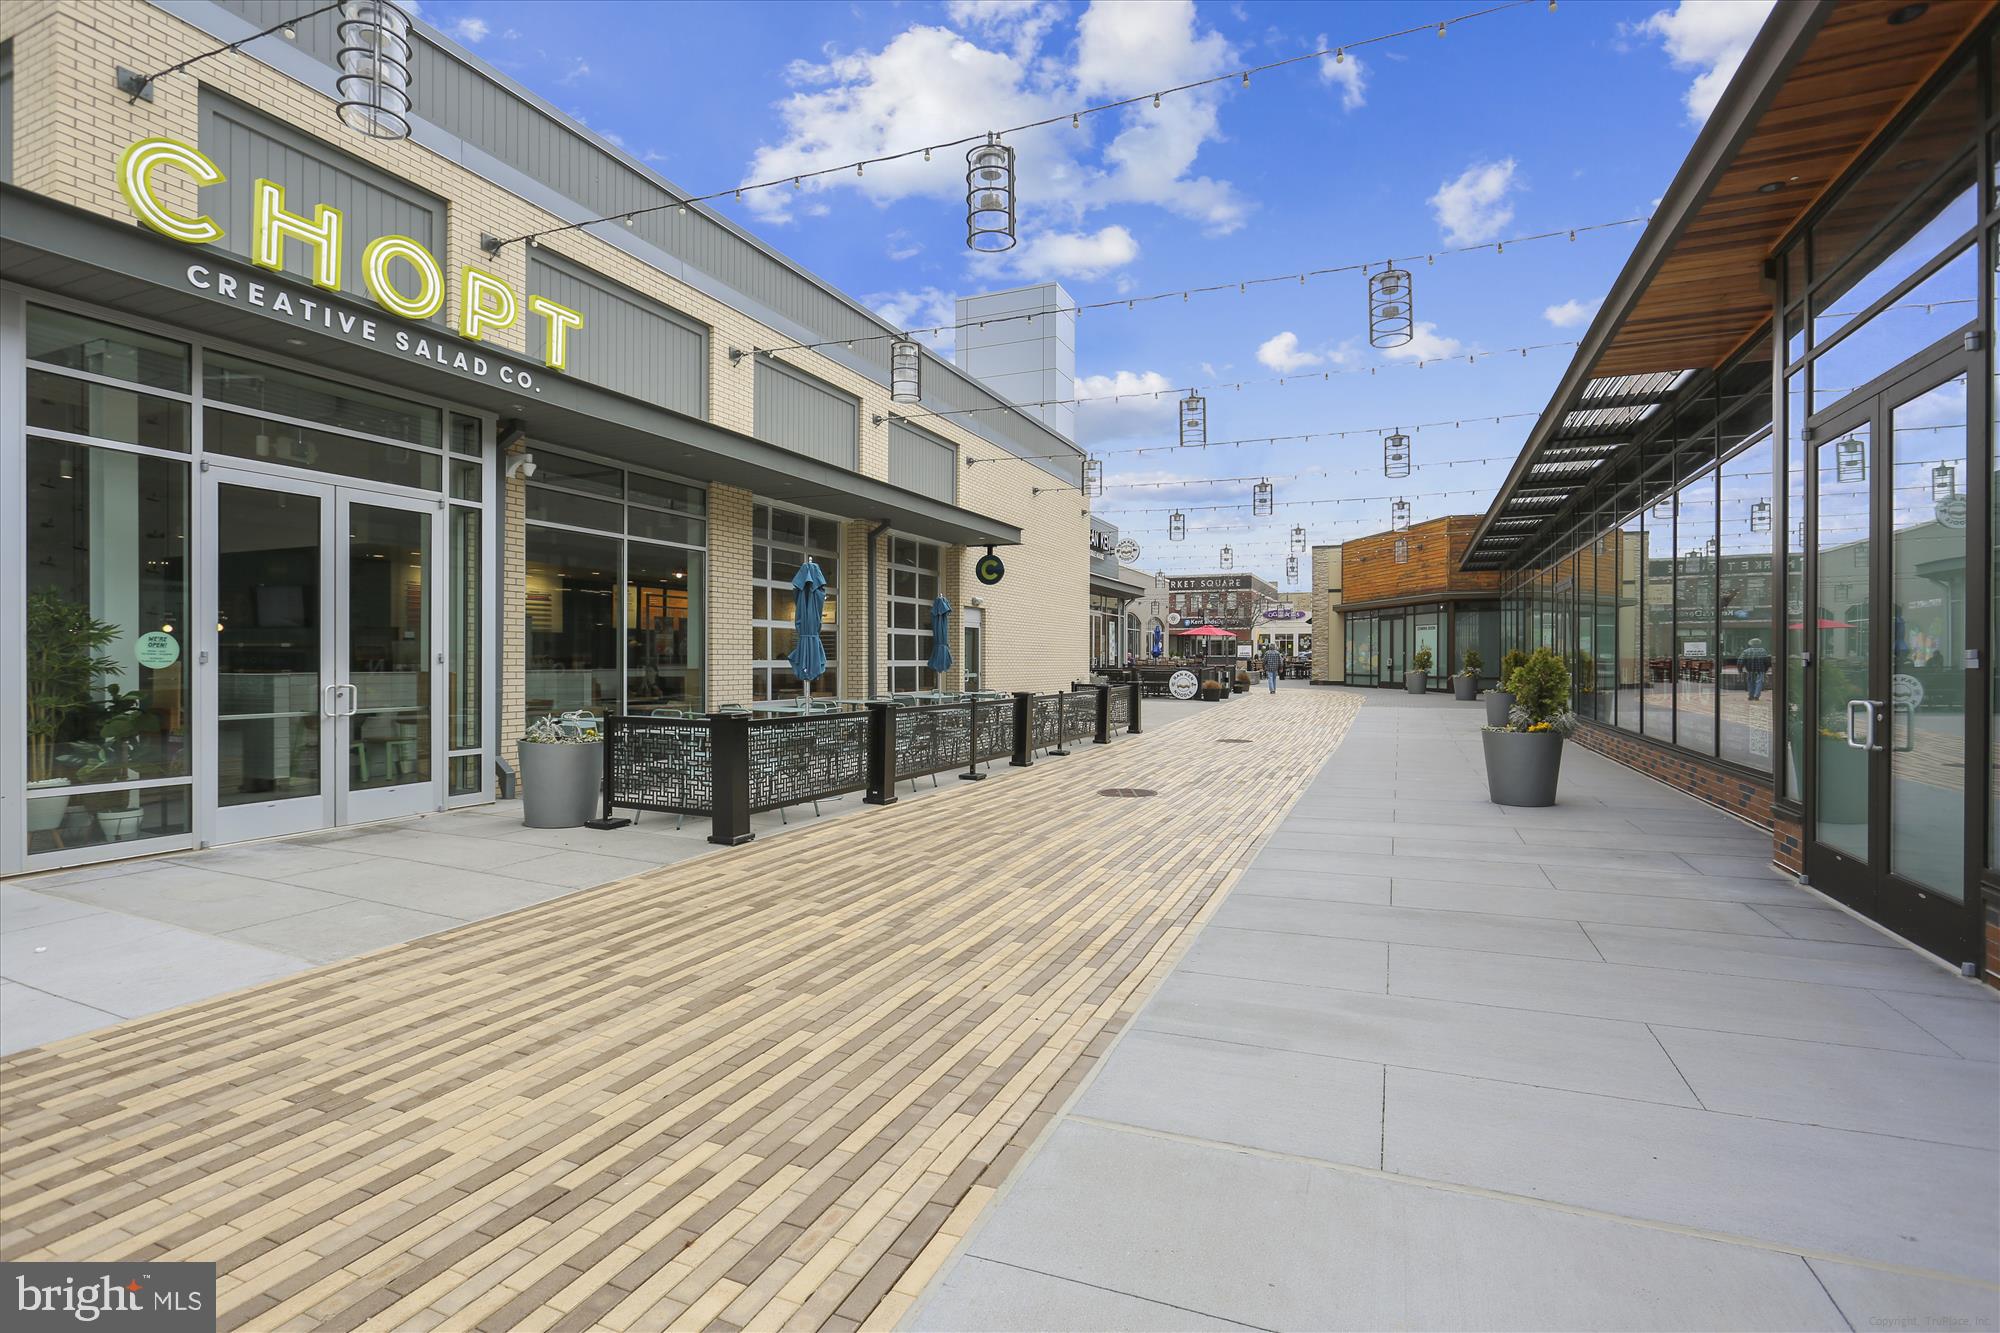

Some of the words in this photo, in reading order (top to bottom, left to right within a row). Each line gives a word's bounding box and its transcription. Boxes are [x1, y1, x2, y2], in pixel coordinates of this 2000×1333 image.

[116, 136, 584, 370] CHOPT
[186, 264, 377, 343] CREATIVE
[395, 330, 489, 377] SALAD
[499, 365, 542, 393] CO.
[981, 560, 998, 580] C
[1170, 580, 1195, 588] RKET
[1200, 579, 1241, 587] SQUARE
